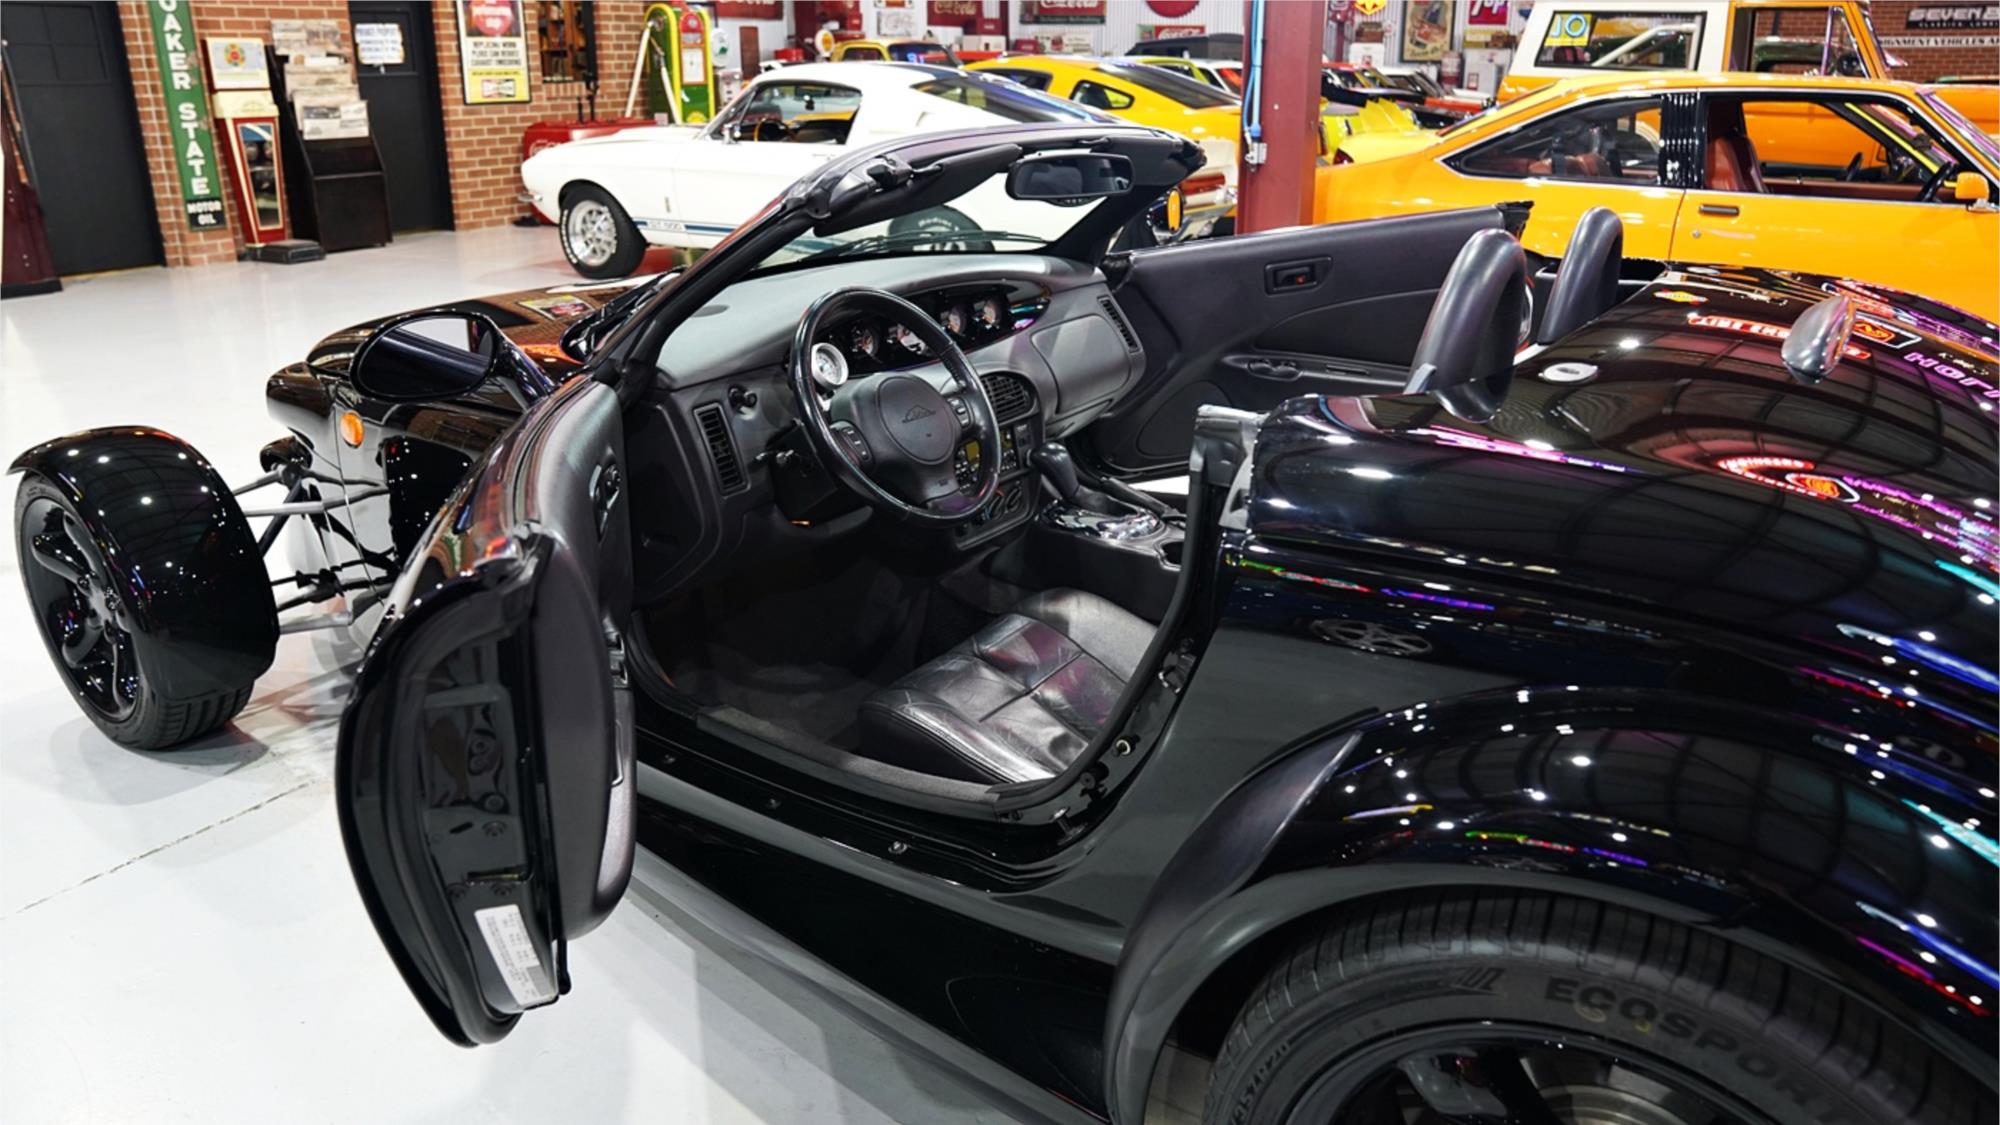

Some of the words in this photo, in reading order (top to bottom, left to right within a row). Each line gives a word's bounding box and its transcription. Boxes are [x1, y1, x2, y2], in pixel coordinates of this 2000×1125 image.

[178, 102, 210, 195] STATE
[187, 200, 221, 213] MOTOR
[197, 213, 216, 225] OIL
